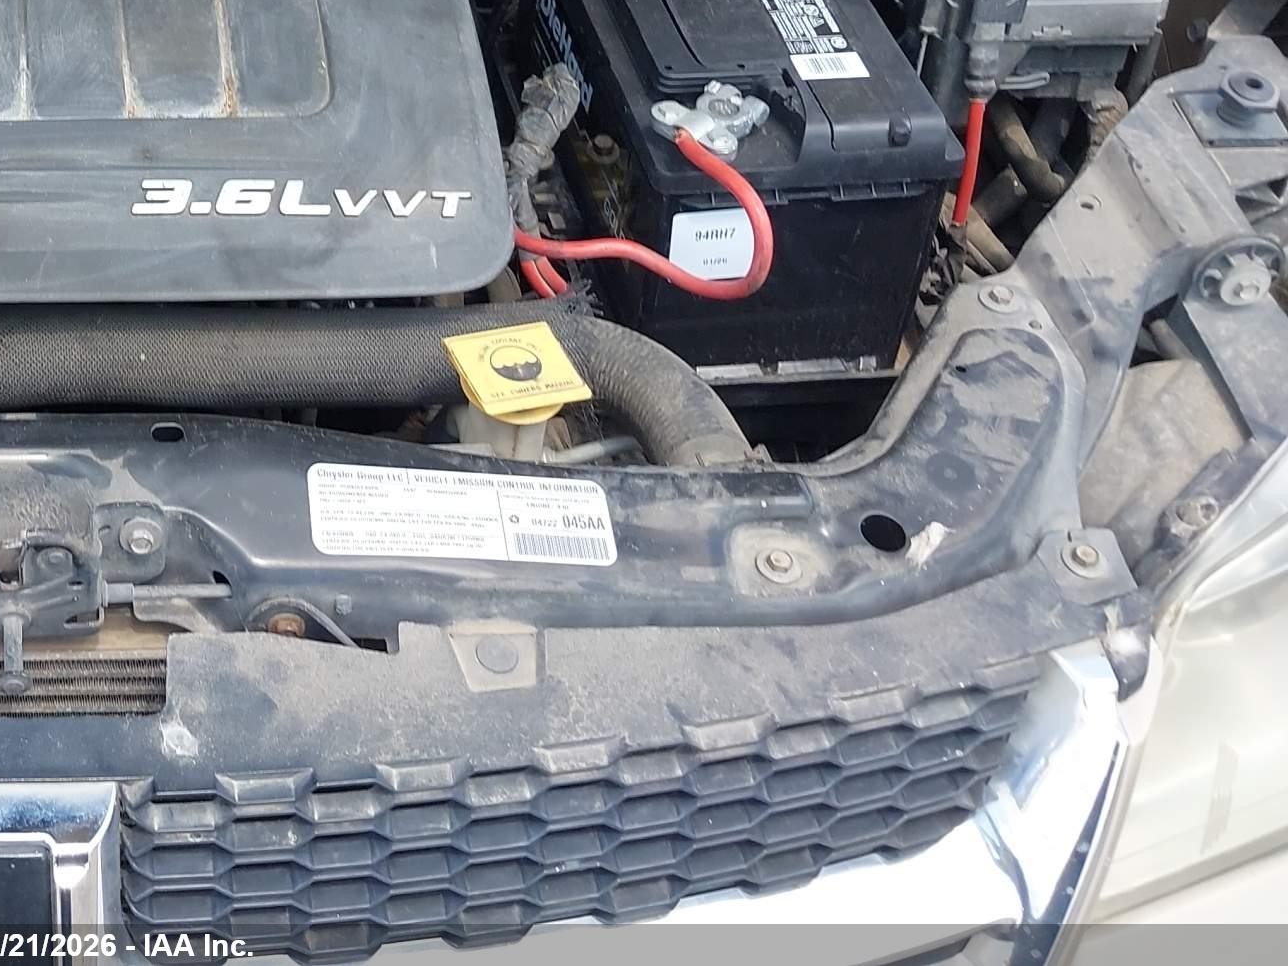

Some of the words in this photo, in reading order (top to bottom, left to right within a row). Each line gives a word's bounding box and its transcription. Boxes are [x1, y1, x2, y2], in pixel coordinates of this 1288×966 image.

[317, 468, 353, 480] Chrysler
[357, 471, 384, 483] Group
[387, 473, 403, 483] LLC
[414, 475, 449, 485] VEHICLE
[452, 477, 494, 487] EMISSION
[497, 480, 535, 490] CONTROL
[539, 482, 599, 494] INFORMATION
